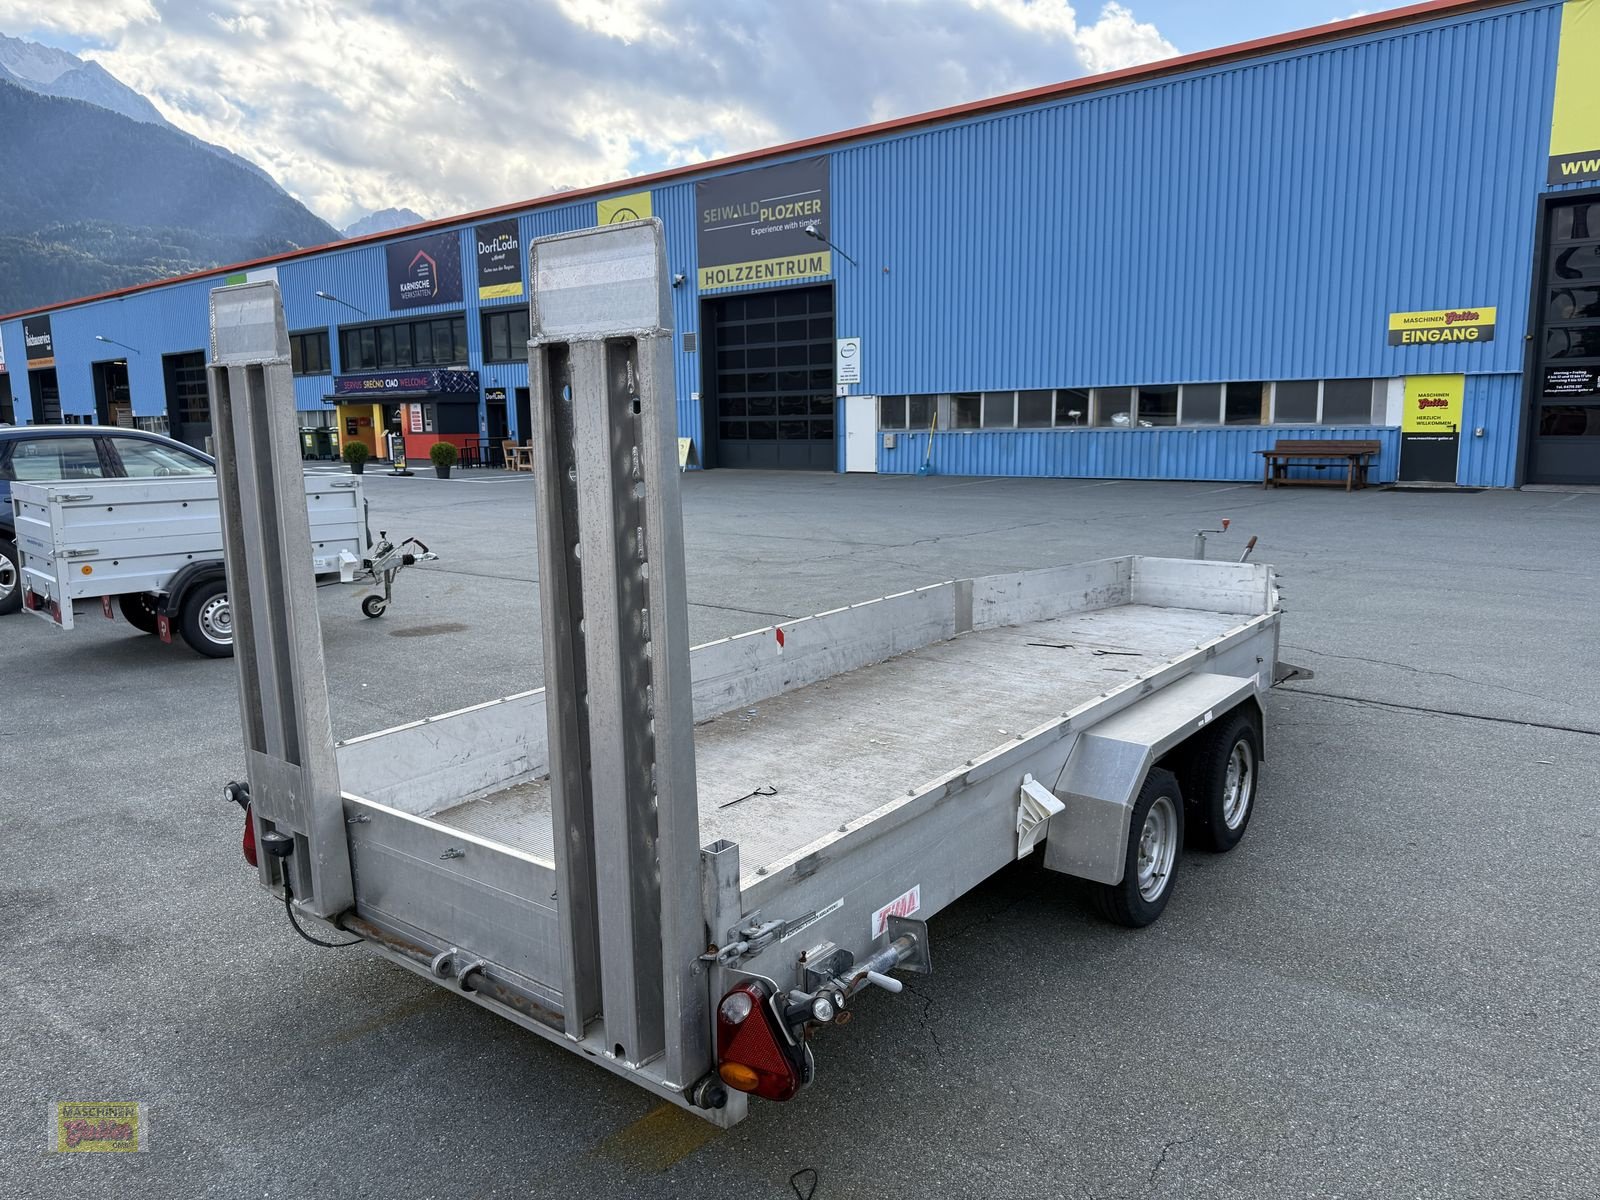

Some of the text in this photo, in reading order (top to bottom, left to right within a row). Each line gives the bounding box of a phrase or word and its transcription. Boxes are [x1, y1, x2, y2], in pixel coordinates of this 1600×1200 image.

[703, 201, 759, 223] SEIWALD
[751, 223, 783, 236] Experience
[784, 219, 799, 230] with
[705, 256, 823, 286] HOLZZENTRUM
[400, 279, 430, 293] KARNISCHE
[1403, 315, 1444, 324] MASCHINEN
[1402, 327, 1479, 343] EINGANG
[385, 378, 399, 388] CIAO
[399, 376, 428, 387] WELCOME
